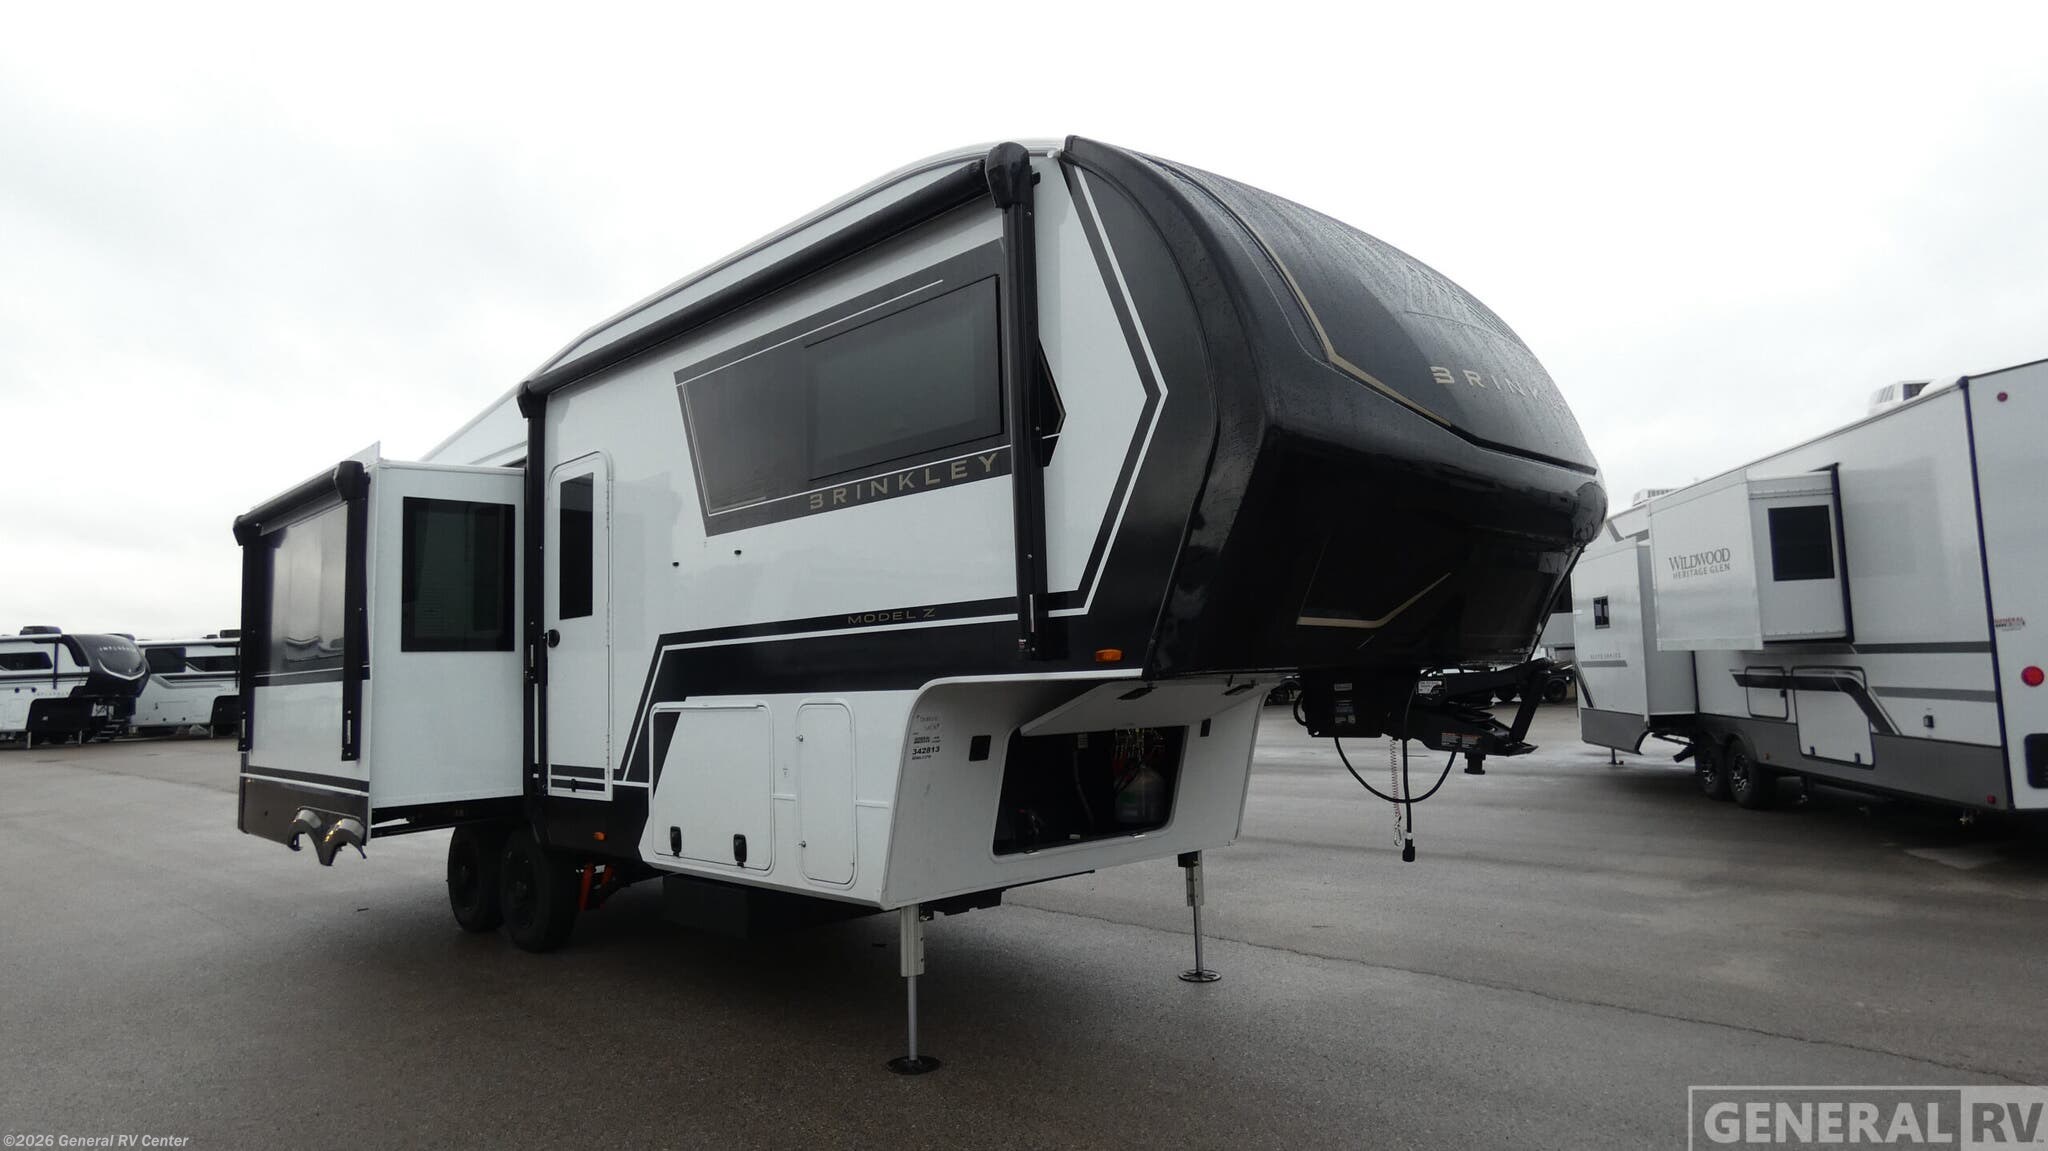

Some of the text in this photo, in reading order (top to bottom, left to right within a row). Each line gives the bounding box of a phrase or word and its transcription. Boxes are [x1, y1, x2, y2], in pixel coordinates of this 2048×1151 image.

[809, 452, 998, 510] BRINKLEY
[1668, 547, 1731, 571] WILDWOOD
[1672, 562, 1731, 580] HERITAGE GLEN
[847, 608, 936, 625] MODEL Z
[911, 746, 940, 755] 342813
